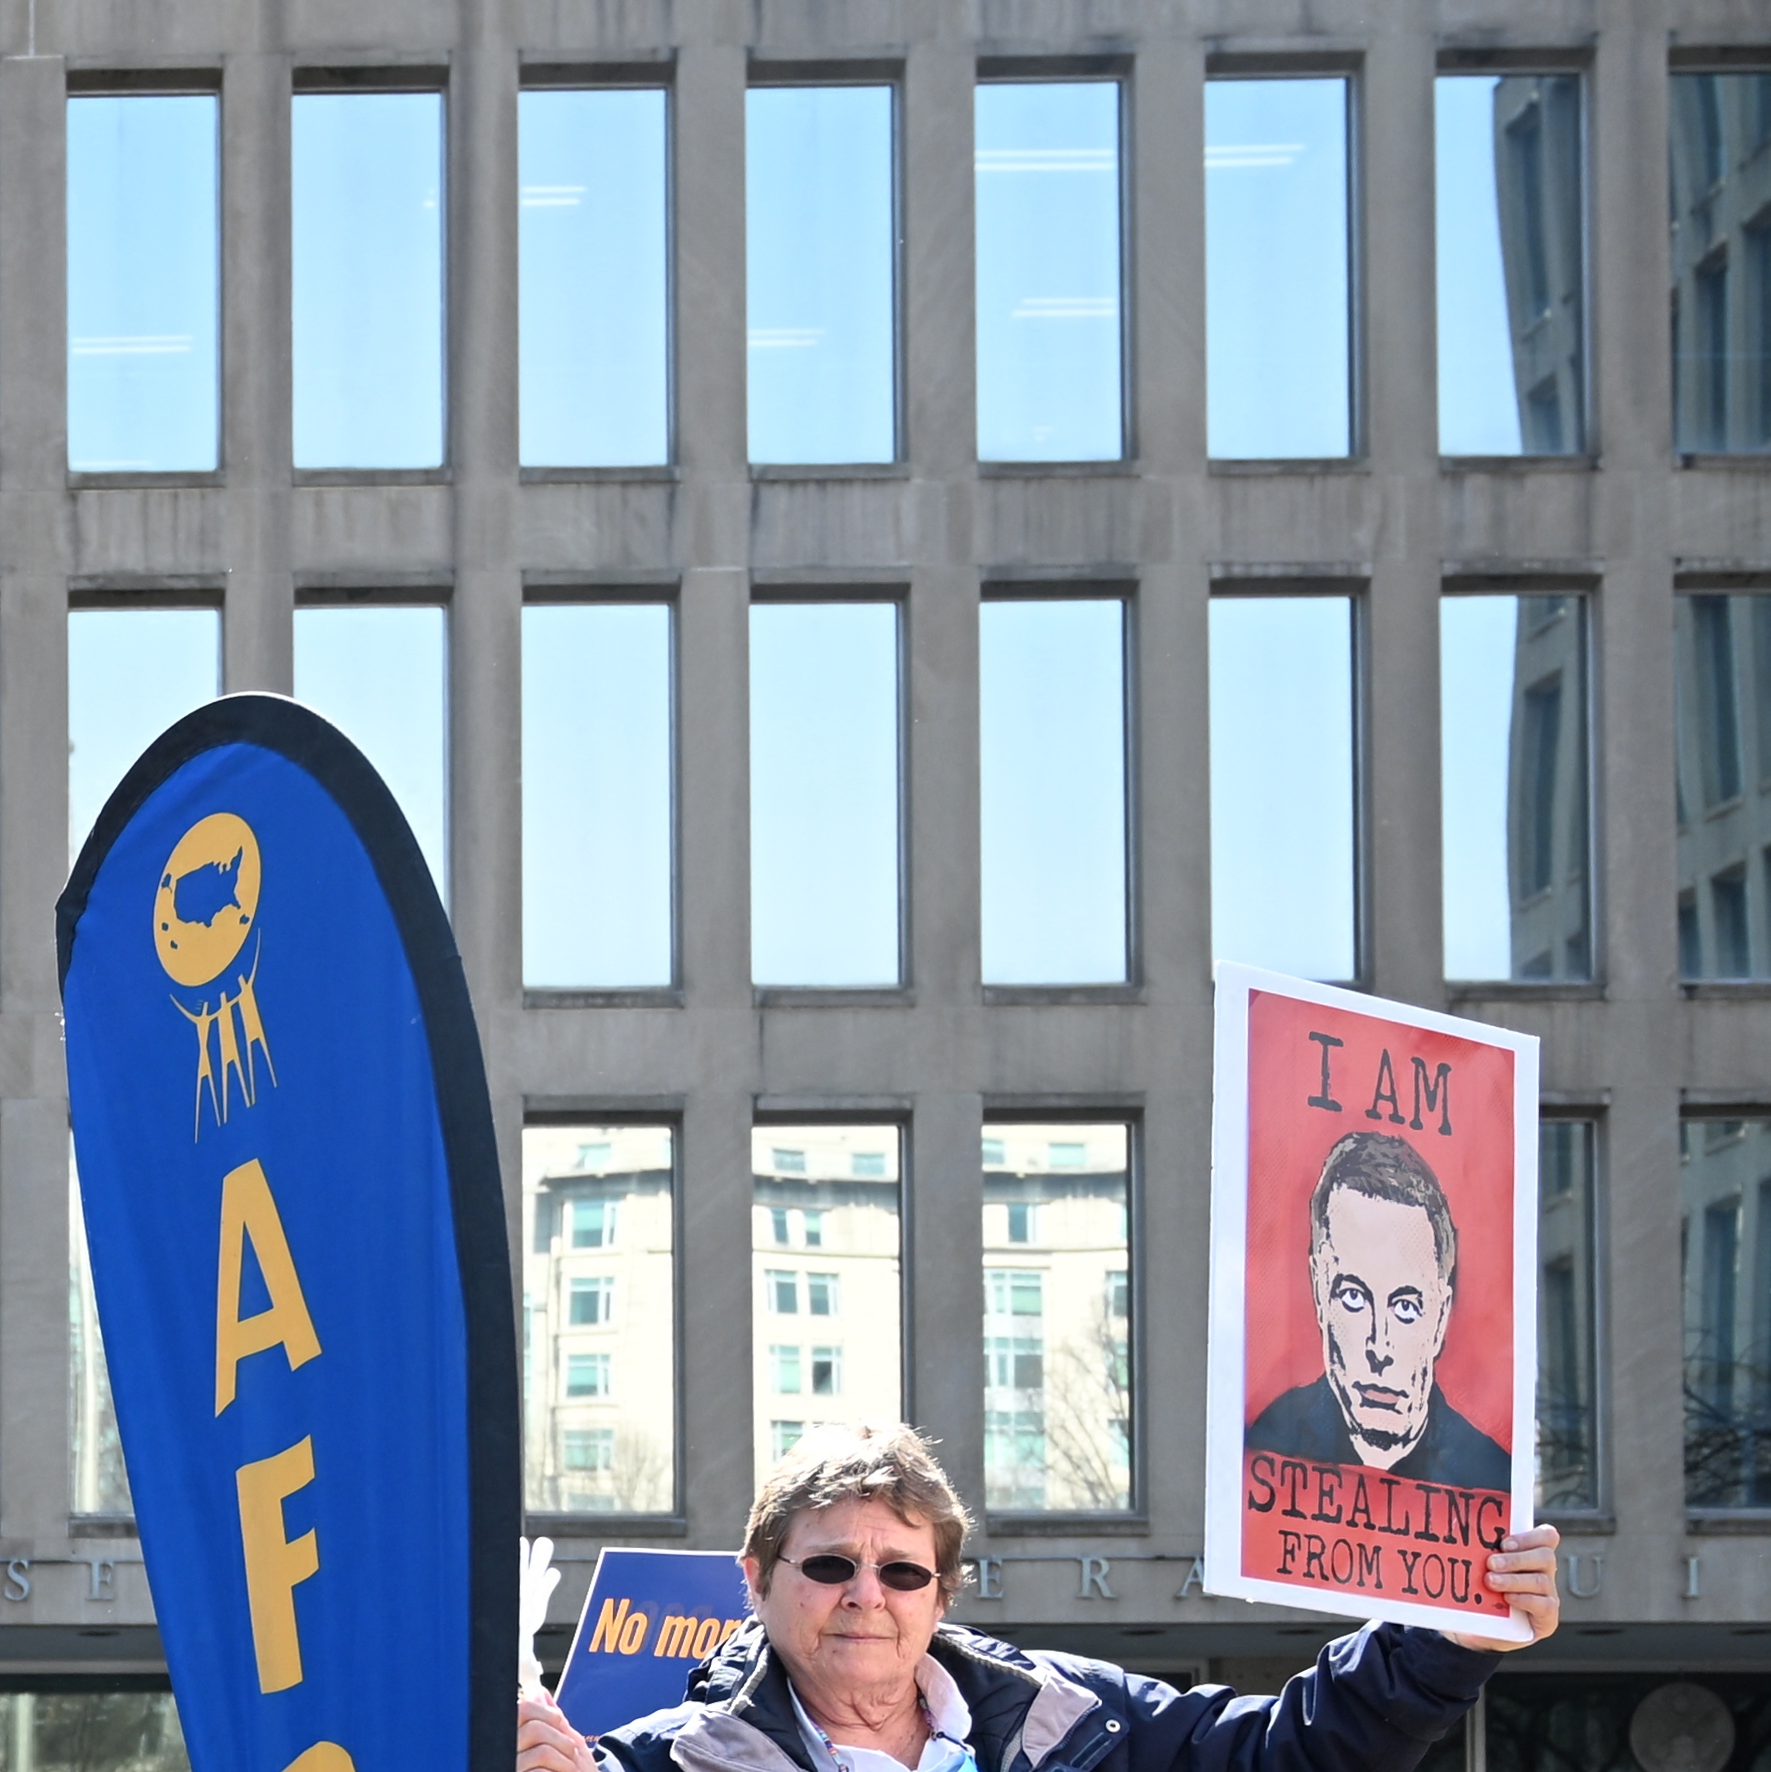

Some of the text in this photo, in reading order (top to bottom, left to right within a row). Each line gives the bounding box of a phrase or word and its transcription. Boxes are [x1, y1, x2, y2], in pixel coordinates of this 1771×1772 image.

[1307, 1031, 1453, 1137] I AM
[1247, 1456, 1506, 1551] STEALING
[1276, 1529, 1383, 1590] FROM
[1400, 1550, 1483, 1606] YOU.
[588, 1597, 744, 1660] No mor
